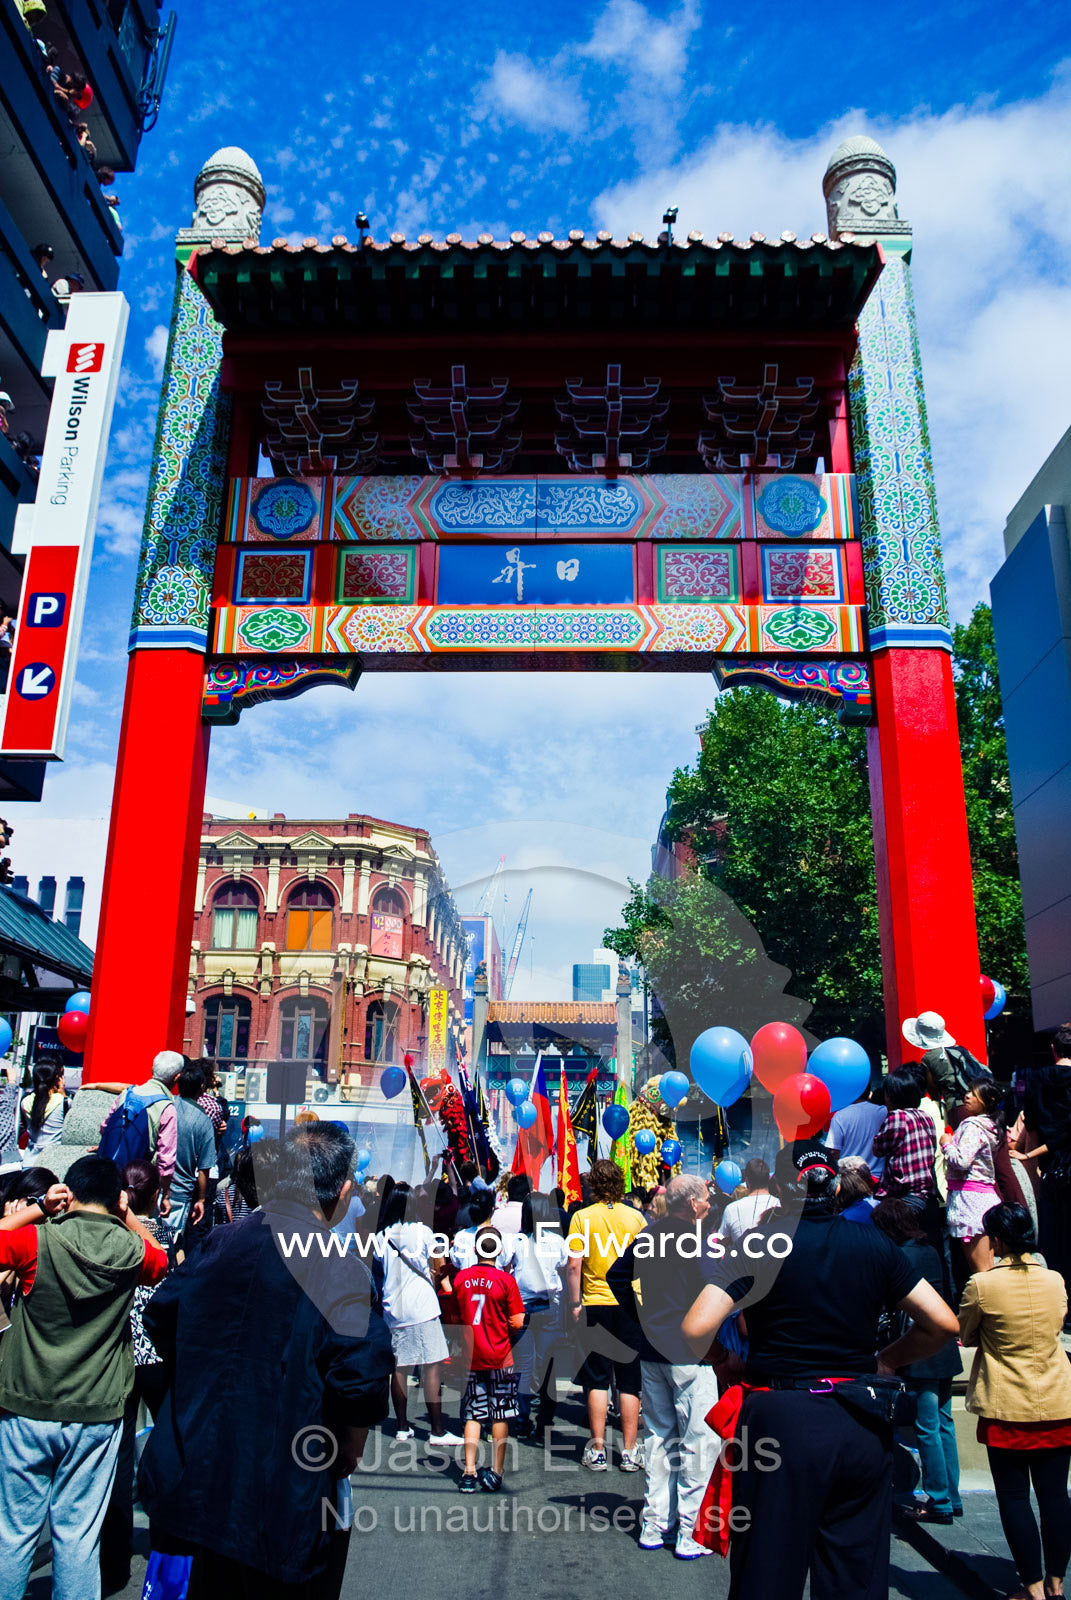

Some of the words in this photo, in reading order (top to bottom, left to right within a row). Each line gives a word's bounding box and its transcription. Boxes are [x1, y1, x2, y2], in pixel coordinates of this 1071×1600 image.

[65, 377, 91, 441] Wilson
[50, 446, 79, 506] Parking
[33, 596, 59, 624] P
[464, 1278, 493, 1289] OWEN
[471, 1293, 486, 1325] 7
